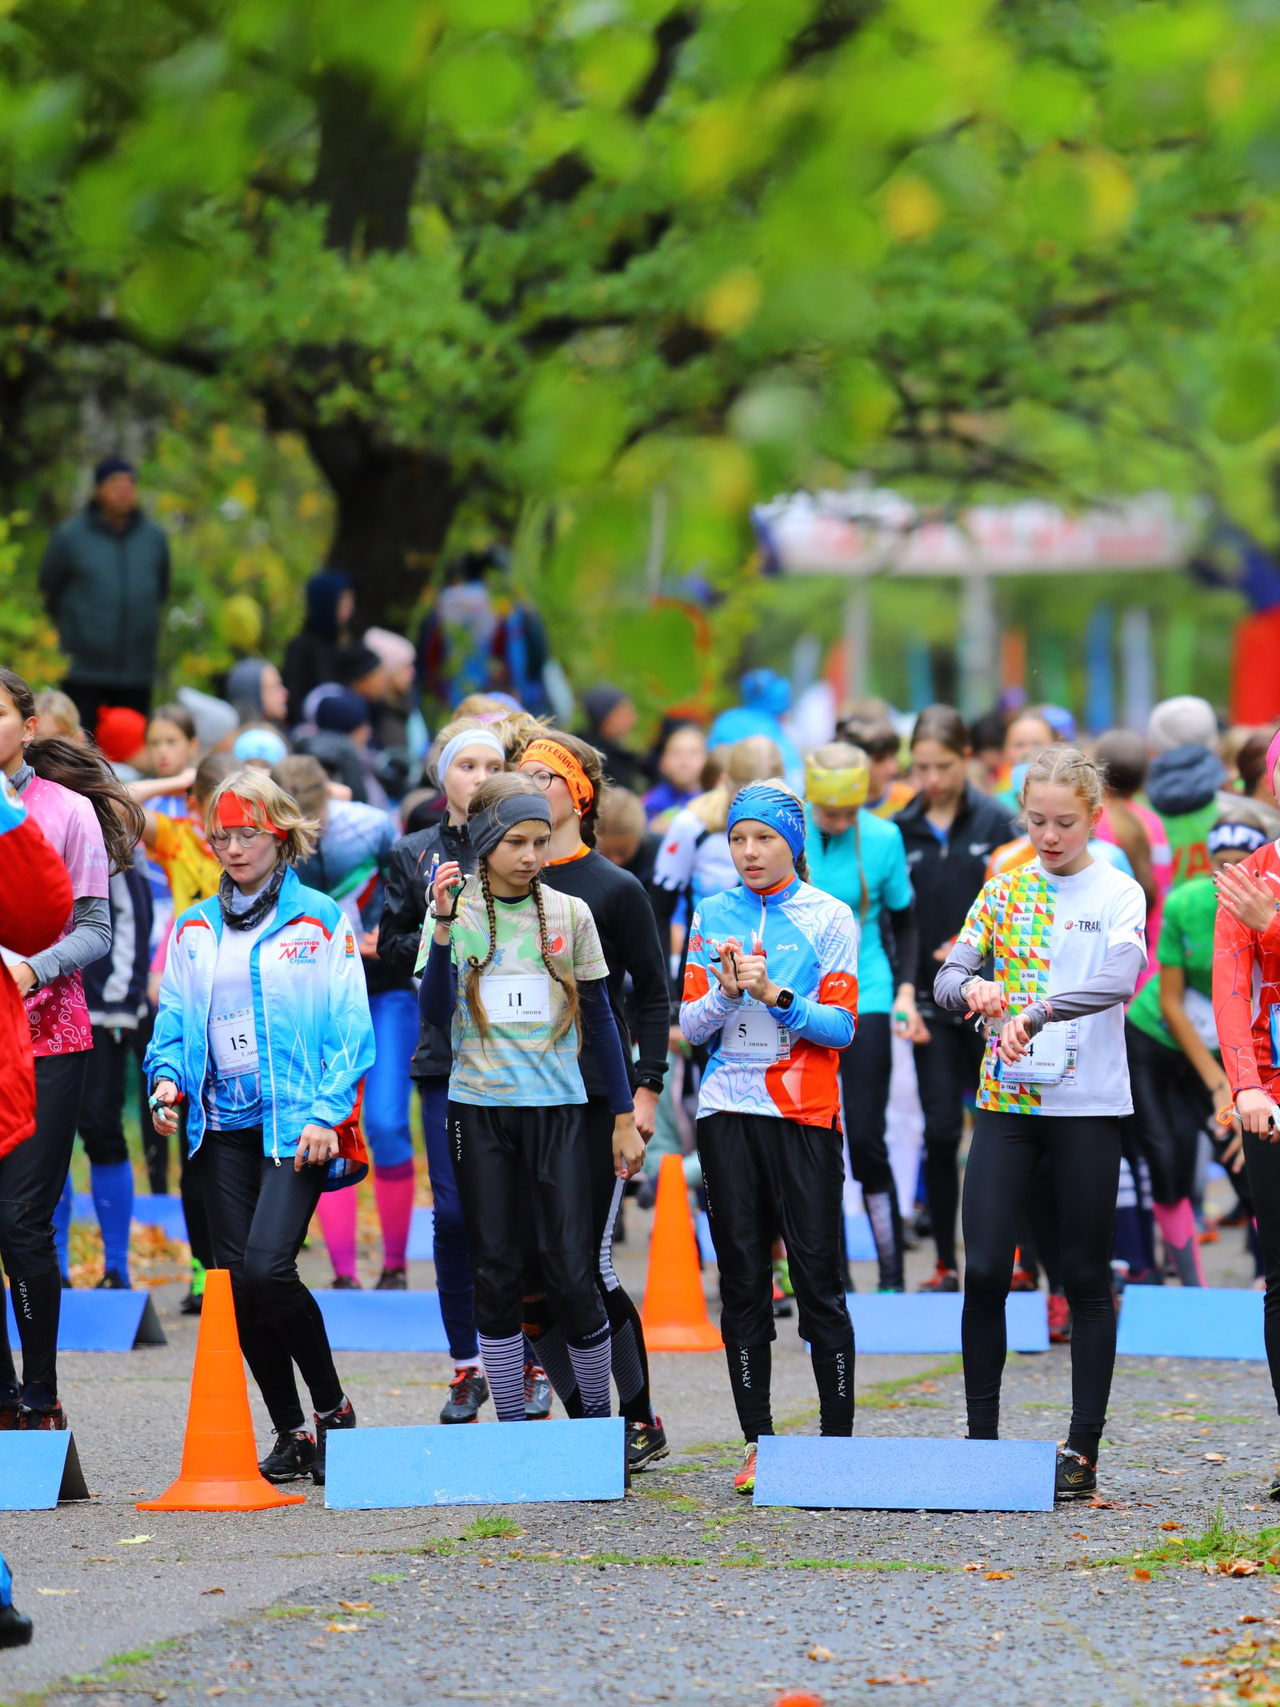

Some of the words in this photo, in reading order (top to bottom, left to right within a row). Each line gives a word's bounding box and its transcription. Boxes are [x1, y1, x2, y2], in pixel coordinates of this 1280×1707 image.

[508, 992, 522, 1006] 11
[738, 1024, 747, 1038] 5
[231, 1034, 248, 1050] 15
[740, 1346, 752, 1388] ARSWEA
[836, 1352, 846, 1398] ARSWEAR
